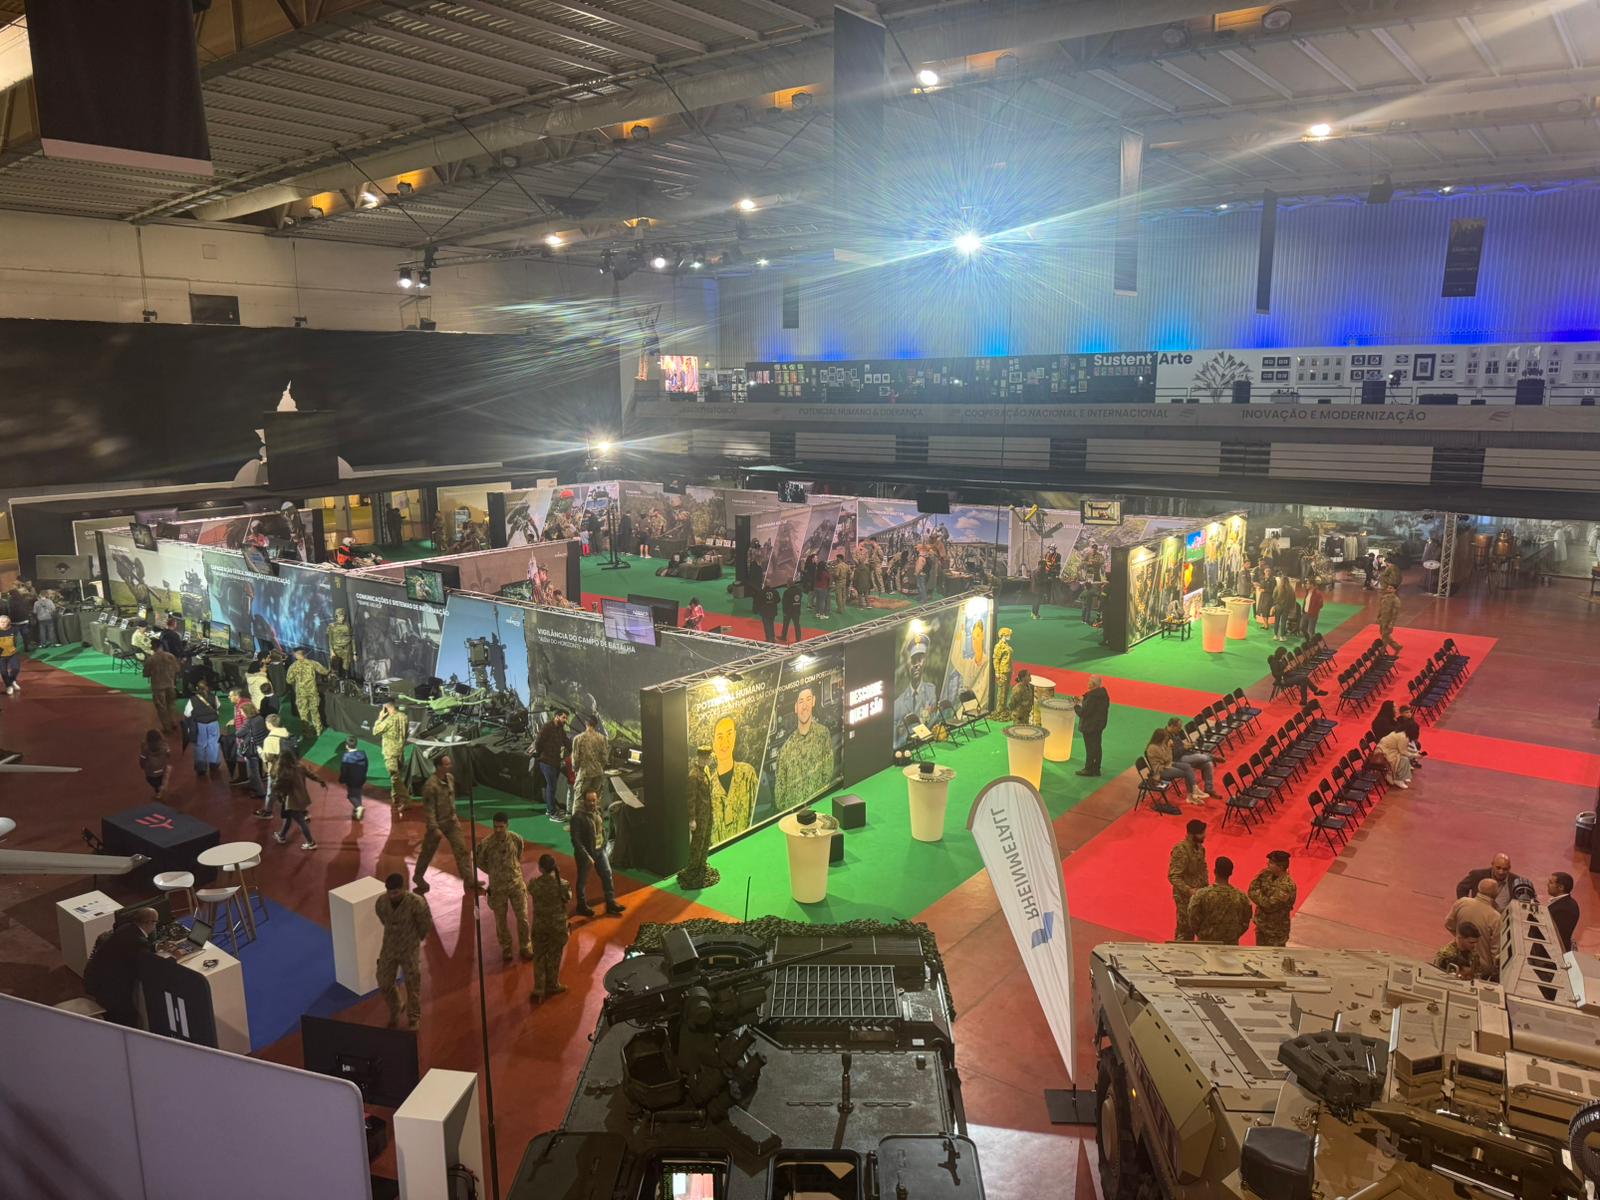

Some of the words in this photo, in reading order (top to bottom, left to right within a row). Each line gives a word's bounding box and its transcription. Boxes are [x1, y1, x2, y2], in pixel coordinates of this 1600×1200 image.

[1028, 409, 1077, 418] NACIONAL
[1078, 409, 1086, 418] E
[1087, 409, 1169, 418] INTERNACIONAL
[1242, 408, 1308, 422] INOVAÇÃO
[1310, 410, 1317, 419] E
[1318, 410, 1427, 424] MODERNIZAÇÃO
[536, 627, 568, 640] VIGILÂNCIA
[568, 634, 578, 642] DO
[578, 635, 600, 647] CAMPO
[600, 640, 608, 648] DE
[608, 641, 636, 653] BATALHA
[735, 681, 766, 698] HUMANO
